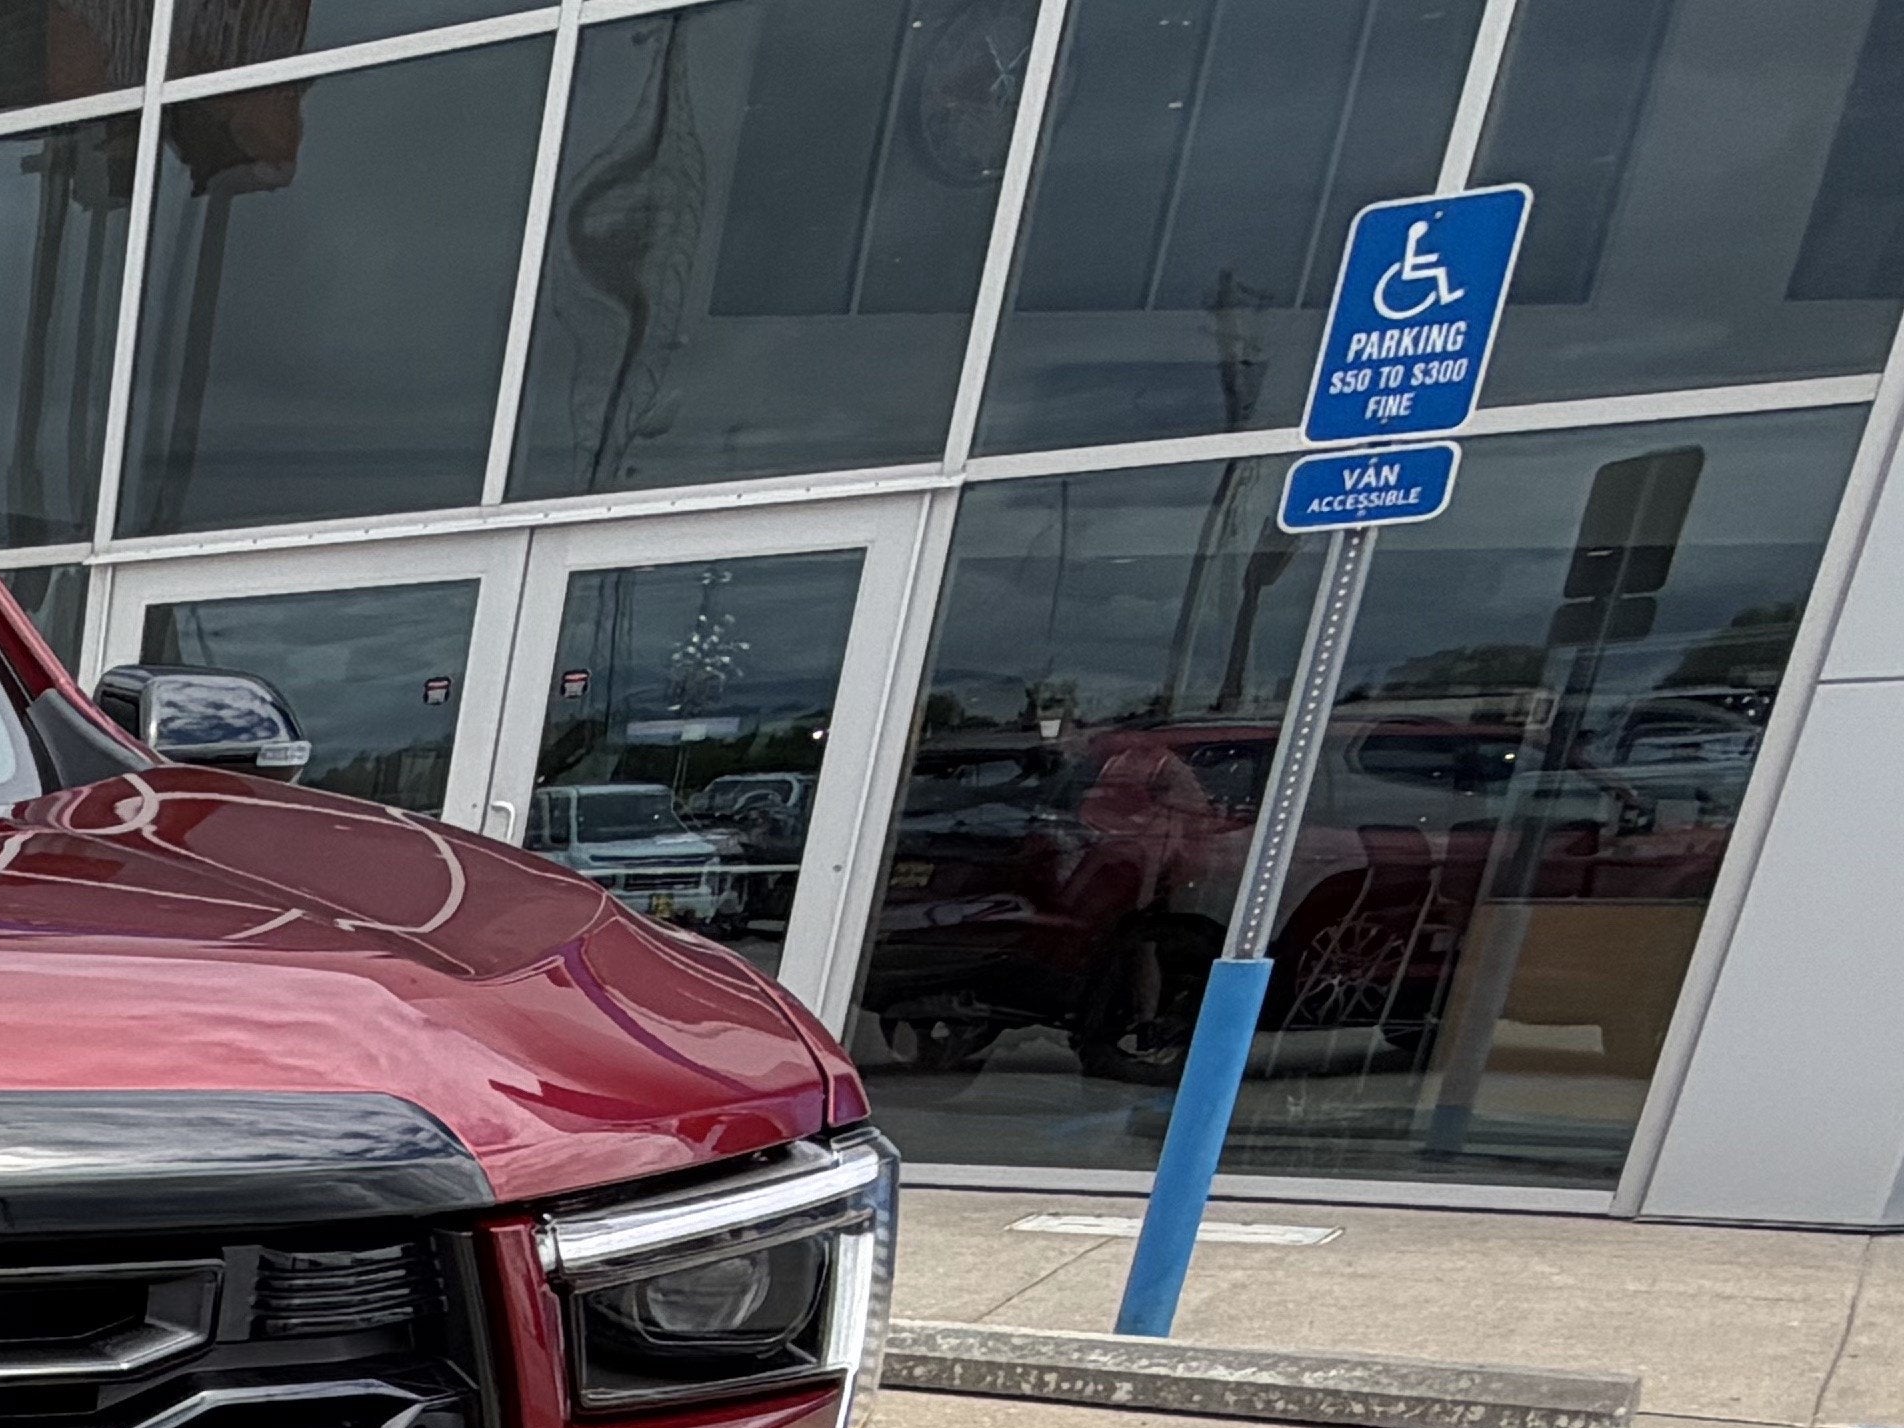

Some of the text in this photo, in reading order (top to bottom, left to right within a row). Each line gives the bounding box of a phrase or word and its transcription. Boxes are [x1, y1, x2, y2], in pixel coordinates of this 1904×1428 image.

[1346, 320, 1468, 364] PARKING
[1378, 365, 1404, 390] TO
[1365, 392, 1416, 421] FINE
[1343, 463, 1400, 490] VAN
[1306, 487, 1421, 513] ACCESSIBLE
